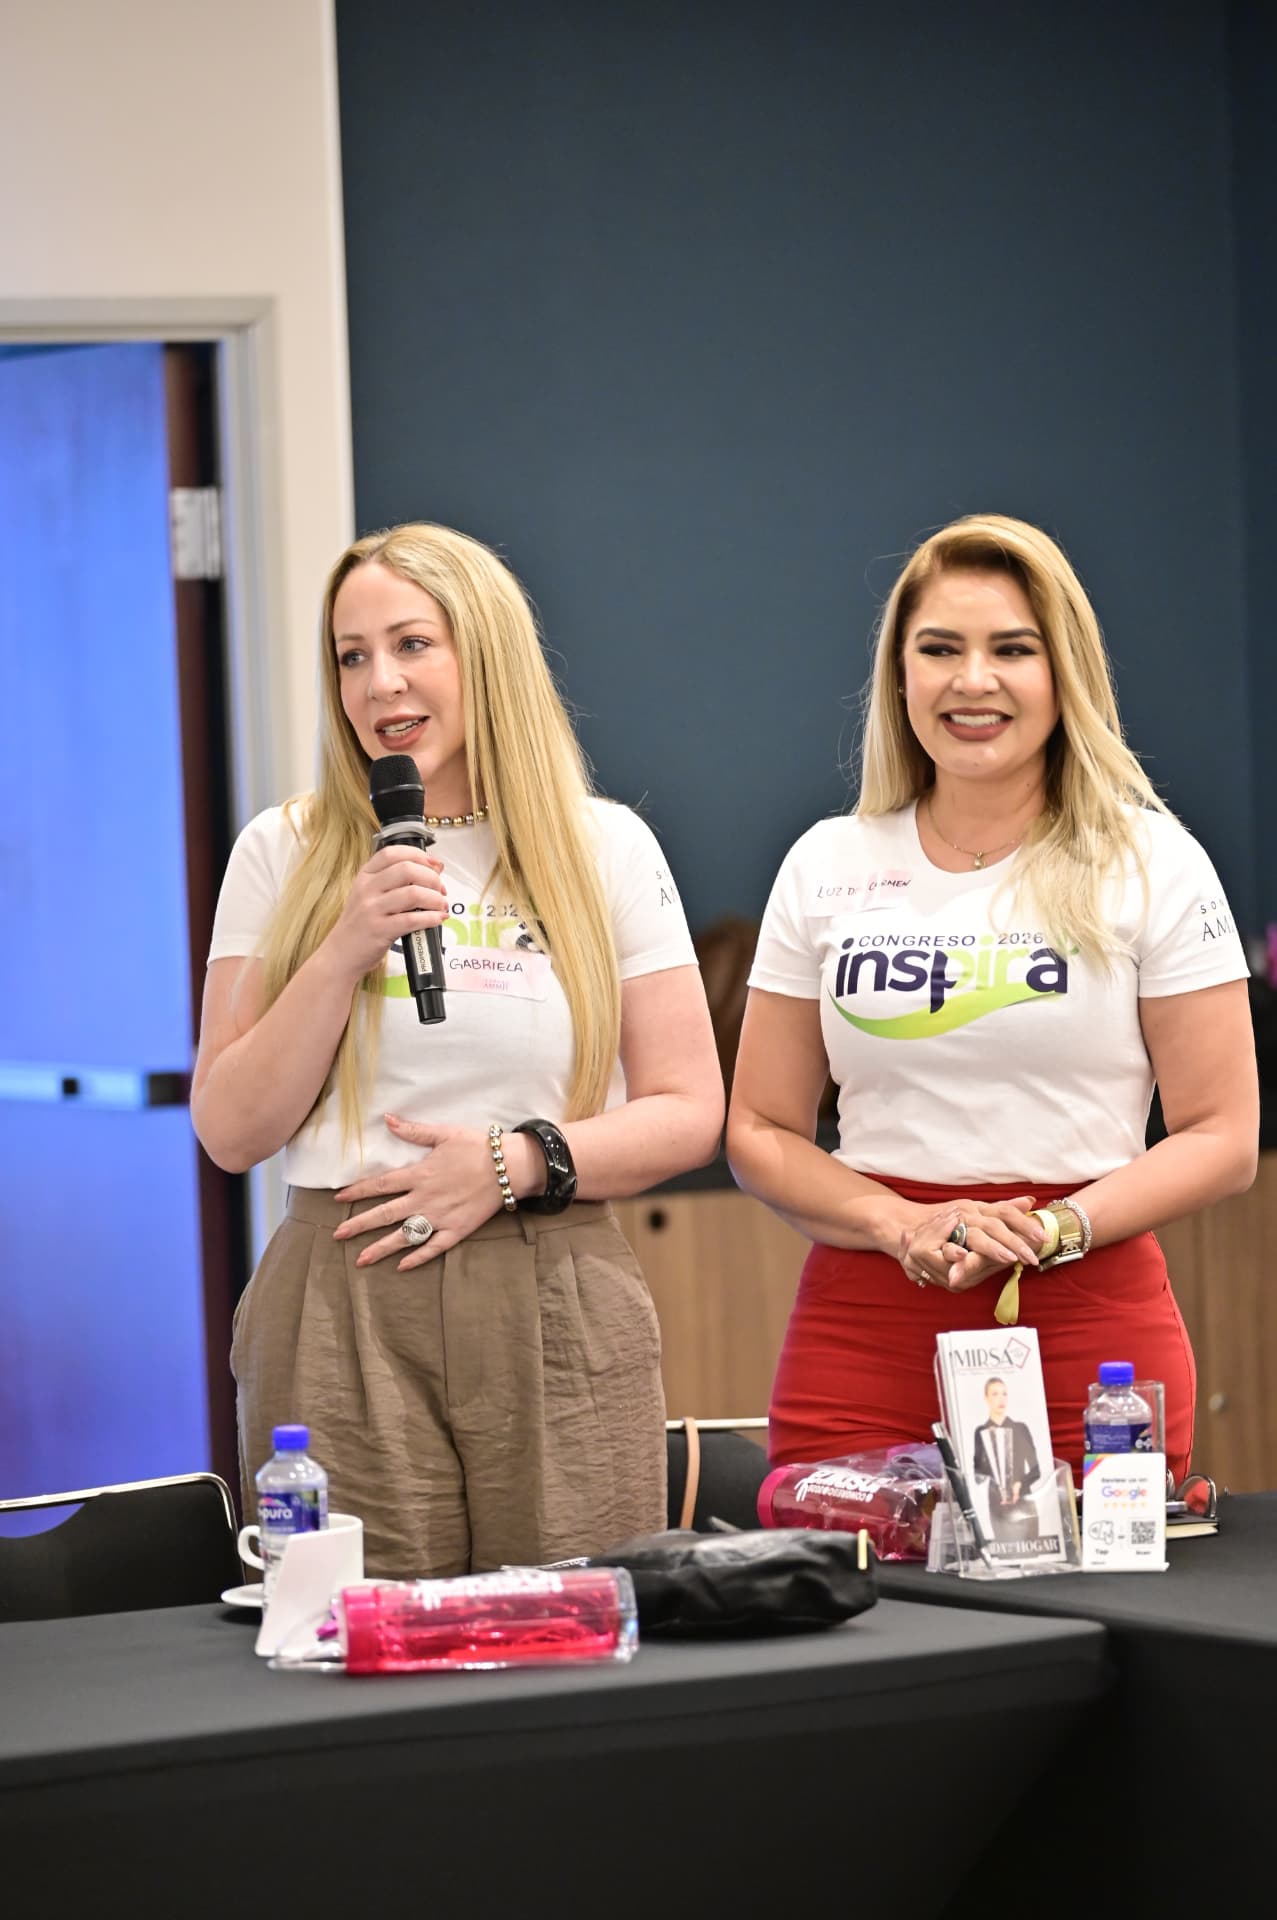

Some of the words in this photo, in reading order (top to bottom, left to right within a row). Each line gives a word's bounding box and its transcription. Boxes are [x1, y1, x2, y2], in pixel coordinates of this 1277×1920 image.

[817, 886, 843, 898] LUZ
[858, 934, 976, 948] CONGRESO
[997, 932, 1044, 945] 2026
[449, 957, 524, 973] GABRIELA
[835, 936, 1068, 1014] inspira
[953, 1347, 1014, 1368] MIRSA
[1101, 1485, 1147, 1500] Google
[1015, 1538, 1059, 1554] HOGAR
